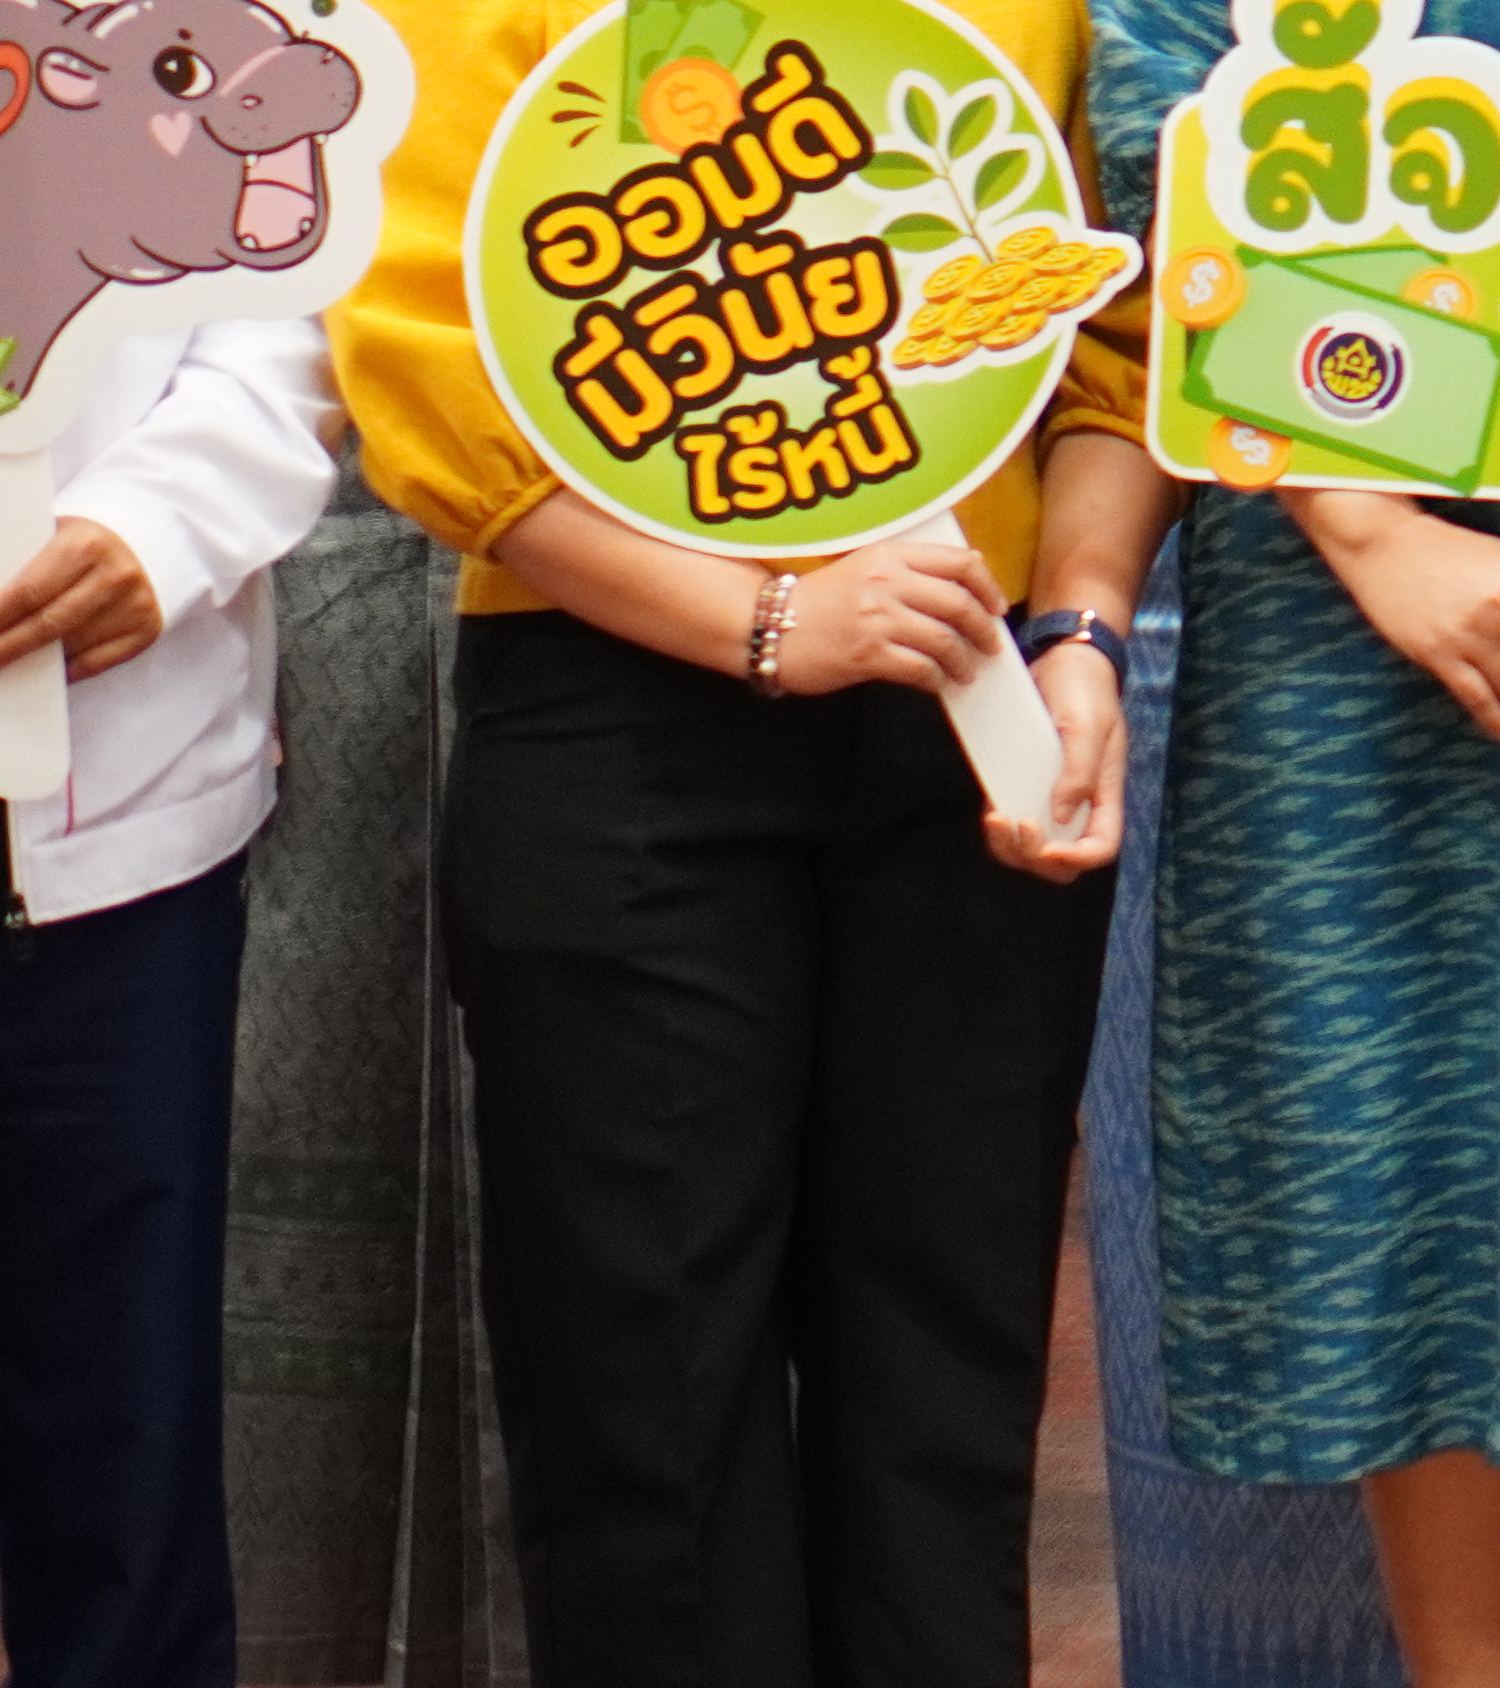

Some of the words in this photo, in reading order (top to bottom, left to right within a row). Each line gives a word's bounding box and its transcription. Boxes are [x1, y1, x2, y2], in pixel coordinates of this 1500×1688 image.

[526, 45, 868, 293] ออมดี
[560, 237, 894, 454] มีวินัย
[678, 345, 916, 519] ไร้หนี้
